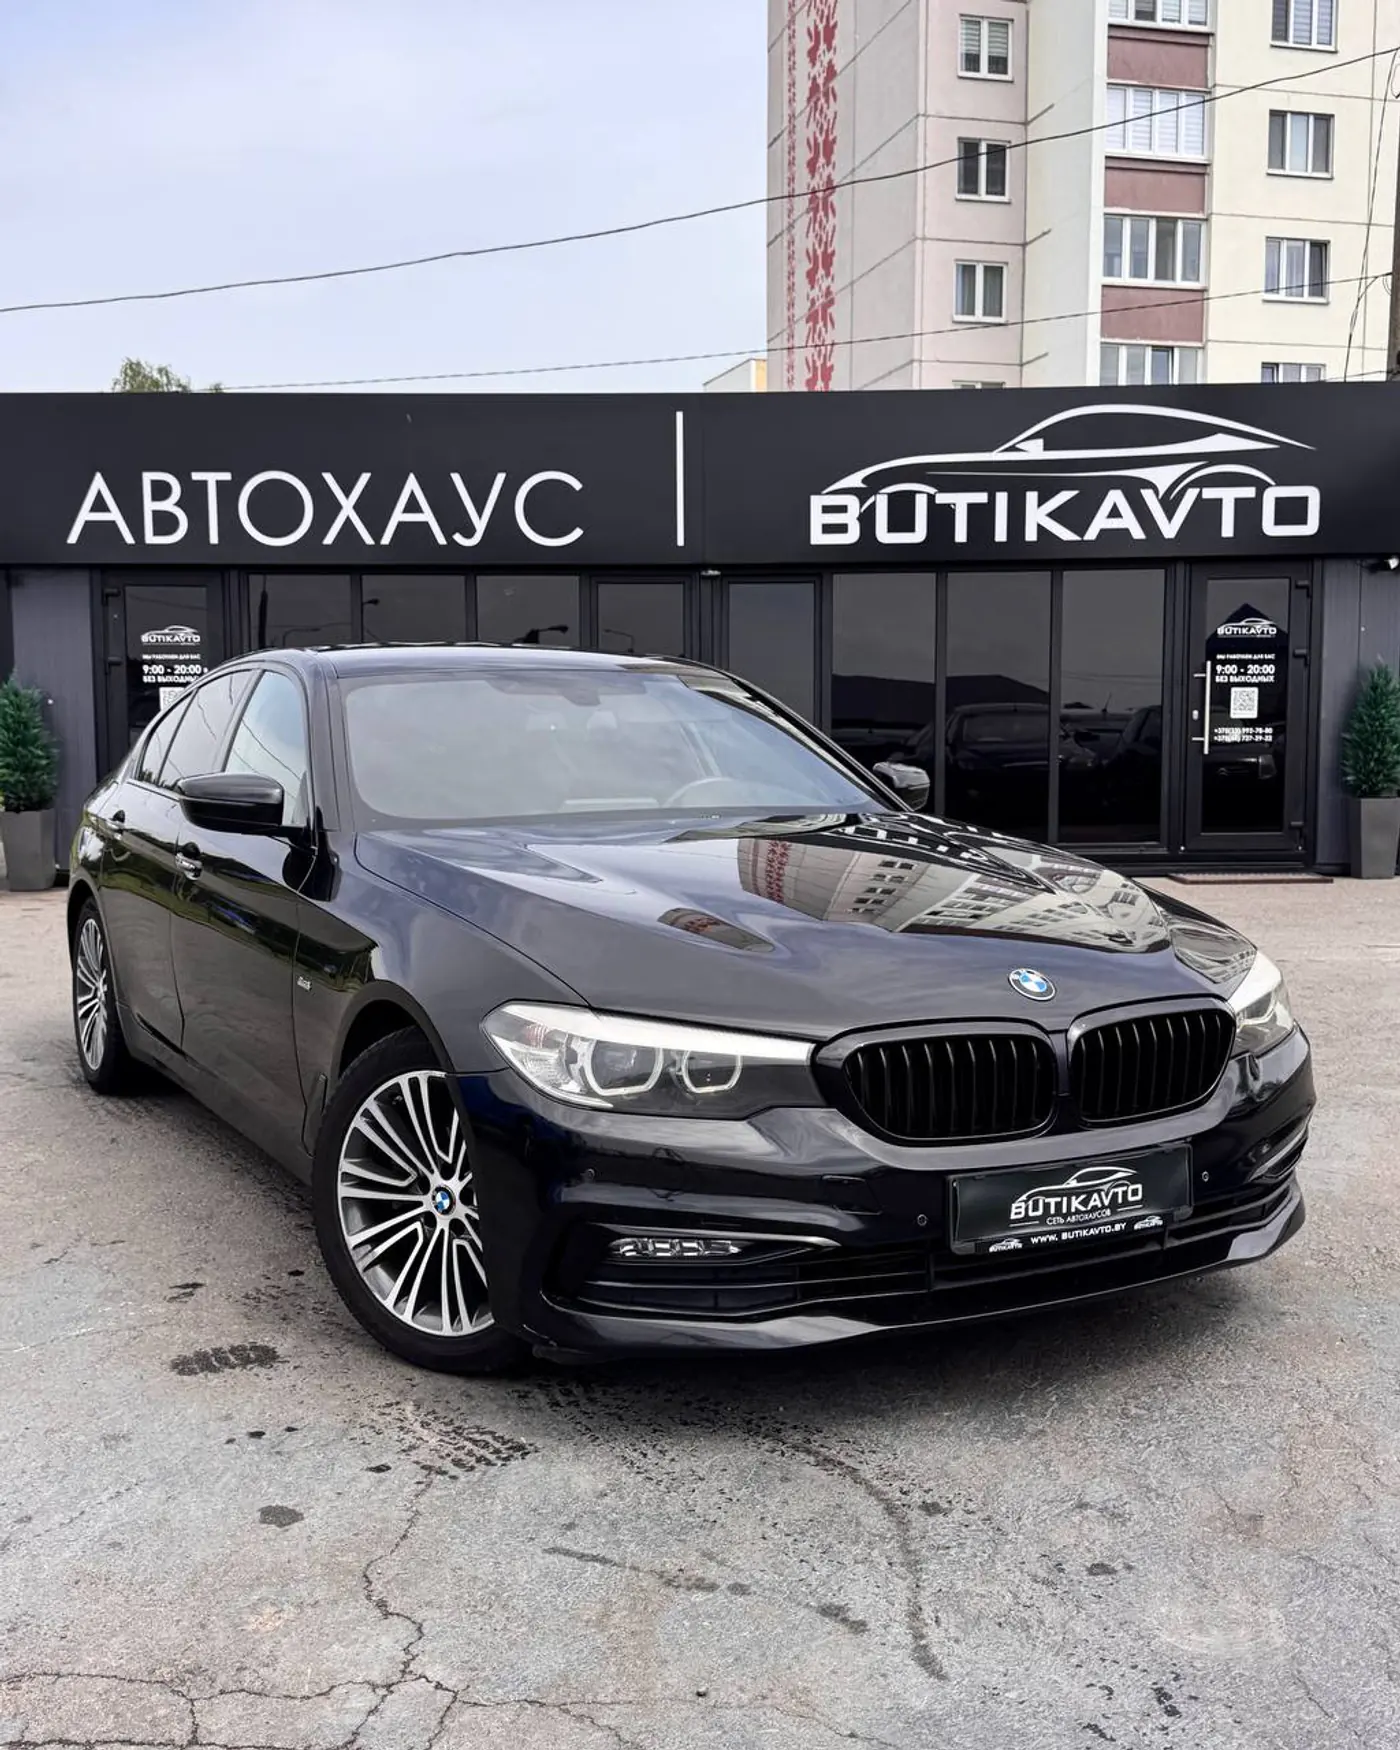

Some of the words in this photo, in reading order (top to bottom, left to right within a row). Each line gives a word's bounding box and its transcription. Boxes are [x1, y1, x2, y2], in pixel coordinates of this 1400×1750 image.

[66, 471, 584, 546] АВТОХАУС
[810, 485, 1320, 545] BUTIKAVTO
[1216, 627, 1277, 635] BUTIKAVTO
[141, 634, 201, 643] BUTIKAVTO
[142, 664, 165, 675] 9:00
[173, 664, 201, 675] 20:00
[1216, 664, 1238, 675] 9:00
[1247, 664, 1276, 675] 20:00
[142, 675, 156, 683] БЕЗ
[1215, 675, 1228, 683] БЕЗ
[1229, 675, 1275, 683] ВЫХОДНЫХ
[1010, 1184, 1143, 1220] BUTIKAVTO
[1046, 1216, 1064, 1226] СЕТЬ
[1066, 1209, 1112, 1223] АВТОХАУСОВ
[1061, 1222, 1127, 1241] BUTIKAVTO.BY
